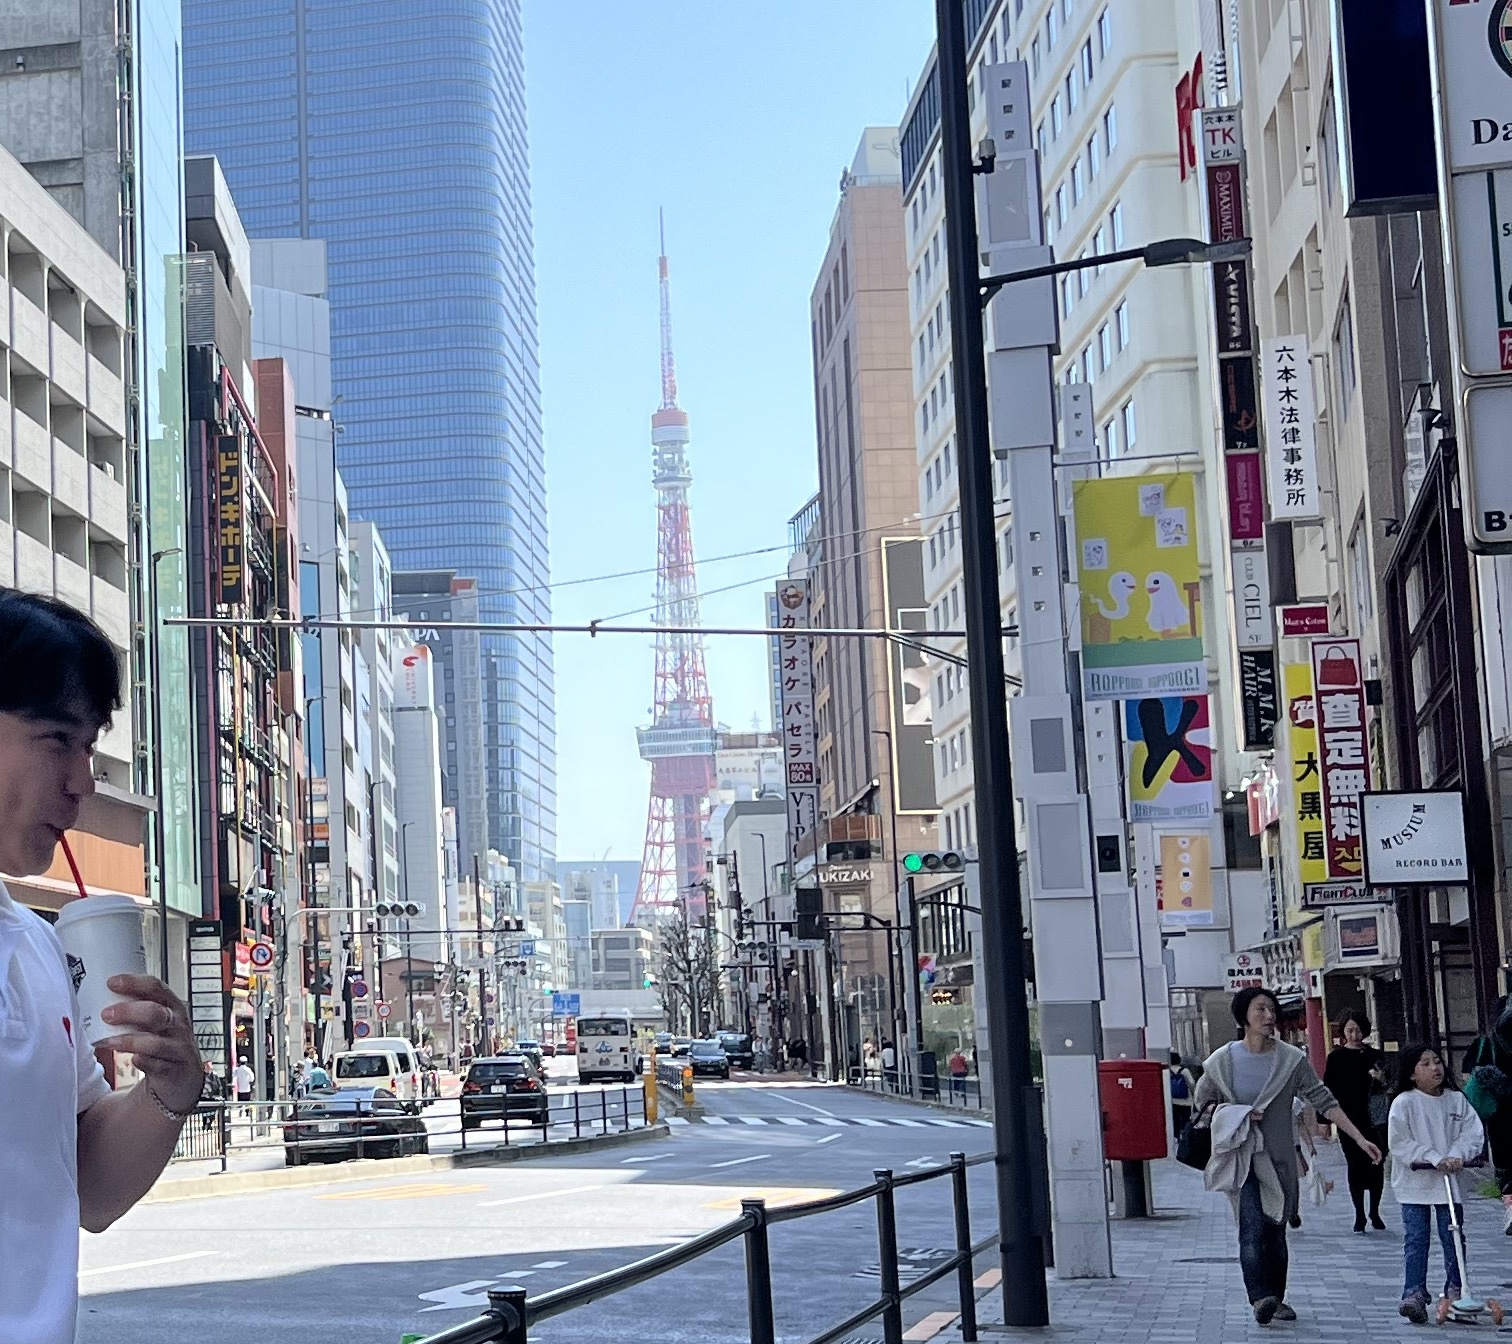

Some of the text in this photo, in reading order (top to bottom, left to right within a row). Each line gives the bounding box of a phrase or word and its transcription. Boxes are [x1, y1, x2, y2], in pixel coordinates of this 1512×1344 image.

[1204, 114, 1235, 125] 六本木
[1205, 127, 1236, 145] TK
[1210, 148, 1233, 159] ビル
[1218, 183, 1234, 243] MAXIMUS
[1275, 346, 1306, 506] 六本木法律事務所
[1484, 510, 1512, 533] B
[1243, 584, 1262, 628] CIEL
[782, 614, 801, 691] カラオケ
[1242, 654, 1258, 697] HAIR
[785, 701, 803, 758] パセラ
[790, 762, 811, 772] MAX
[1322, 692, 1367, 843] 査定無料
[1295, 752, 1325, 861] 大黒屋
[1380, 803, 1426, 851] MUSIUM
[1395, 858, 1463, 868] RECORD BAR
